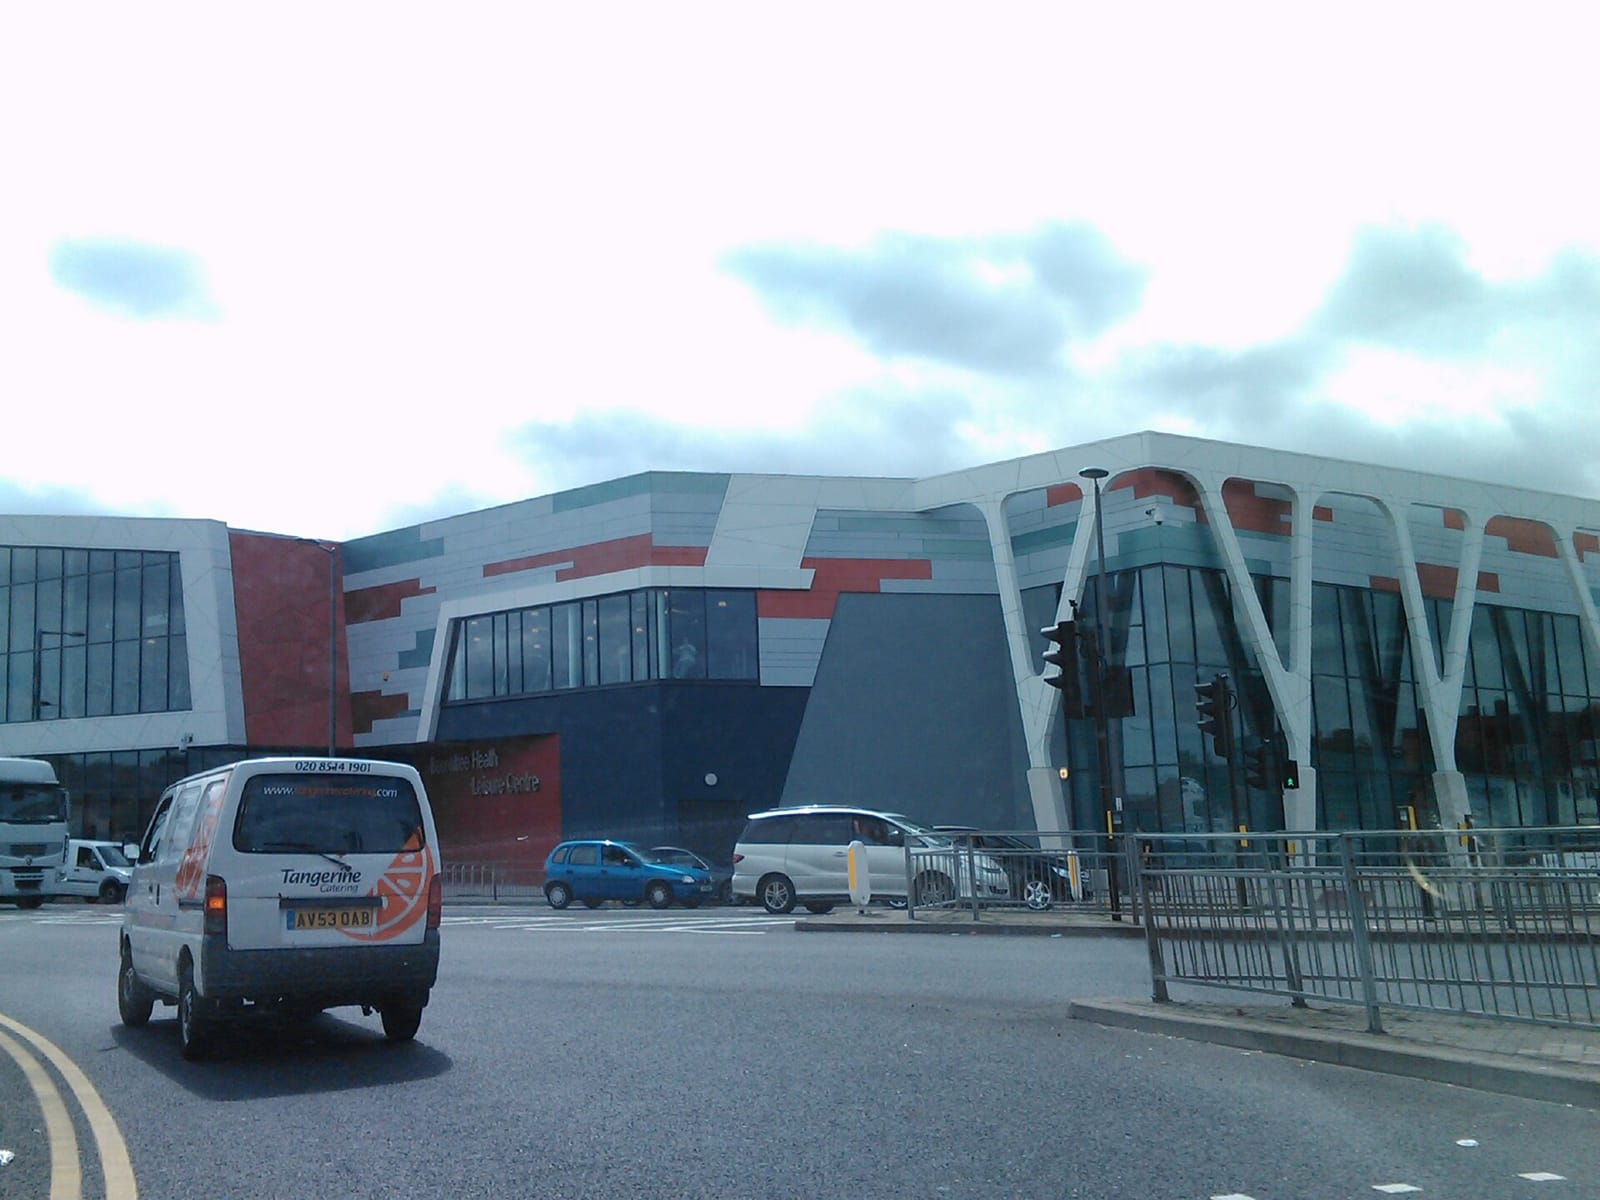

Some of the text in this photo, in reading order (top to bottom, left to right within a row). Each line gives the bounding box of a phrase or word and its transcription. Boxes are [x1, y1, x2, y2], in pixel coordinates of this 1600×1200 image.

[295, 760, 316, 771] 020
[348, 762, 371, 773] 1901
[281, 869, 361, 887] Tangerine
[320, 884, 359, 893] Catering
[297, 911, 336, 927] AV53
